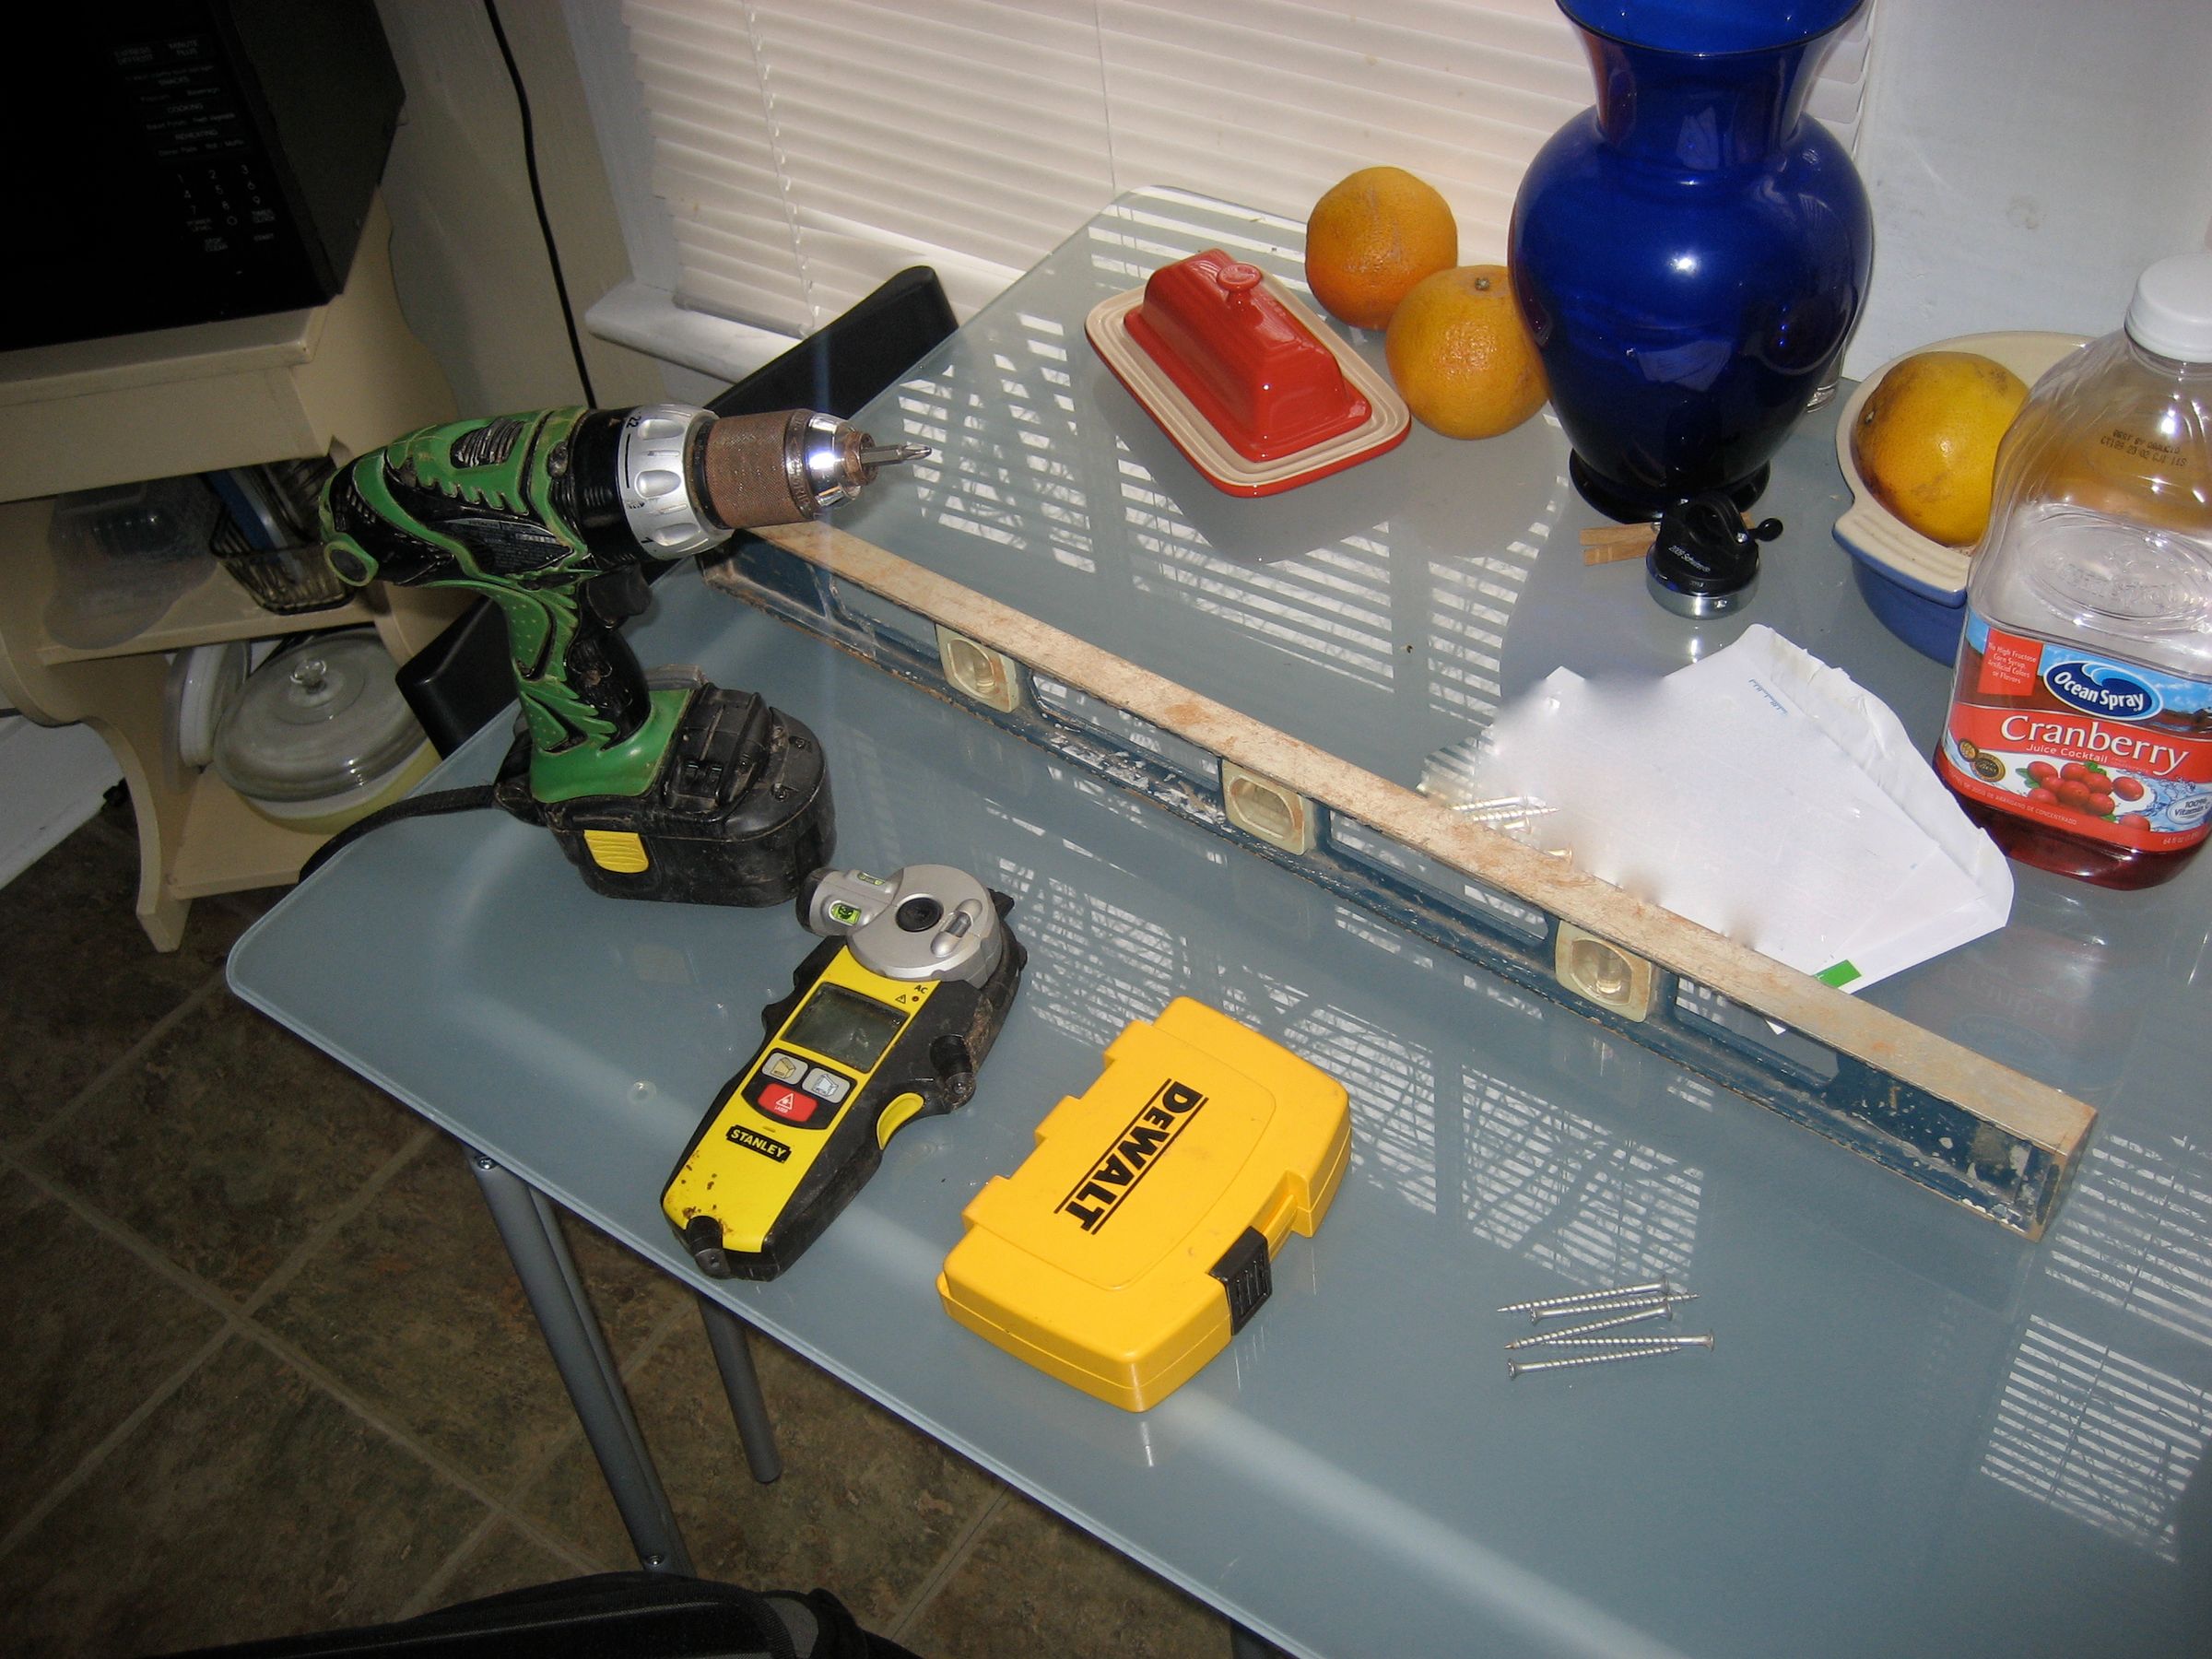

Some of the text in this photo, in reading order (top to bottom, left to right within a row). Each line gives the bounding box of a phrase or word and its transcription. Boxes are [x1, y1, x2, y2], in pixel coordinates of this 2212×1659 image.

[208, 170, 217, 180] 2
[241, 164, 249, 175] 3
[184, 181, 256, 199] 4 5 6
[189, 195, 261, 215] 7 8 9
[1993, 653, 2006, 662] Corn
[1996, 646, 2011, 656] High
[2012, 651, 2037, 663] Fructose
[2012, 667, 2030, 678] Colors
[2054, 671, 2144, 712] Ocean Spray
[2001, 715, 2190, 776] Cranberry
[2026, 743, 2108, 763] Juice Cocktail
[2035, 808, 2077, 826] CONCENTRADO
[914, 984, 928, 994] AC
[731, 1129, 786, 1158] STANLEY
